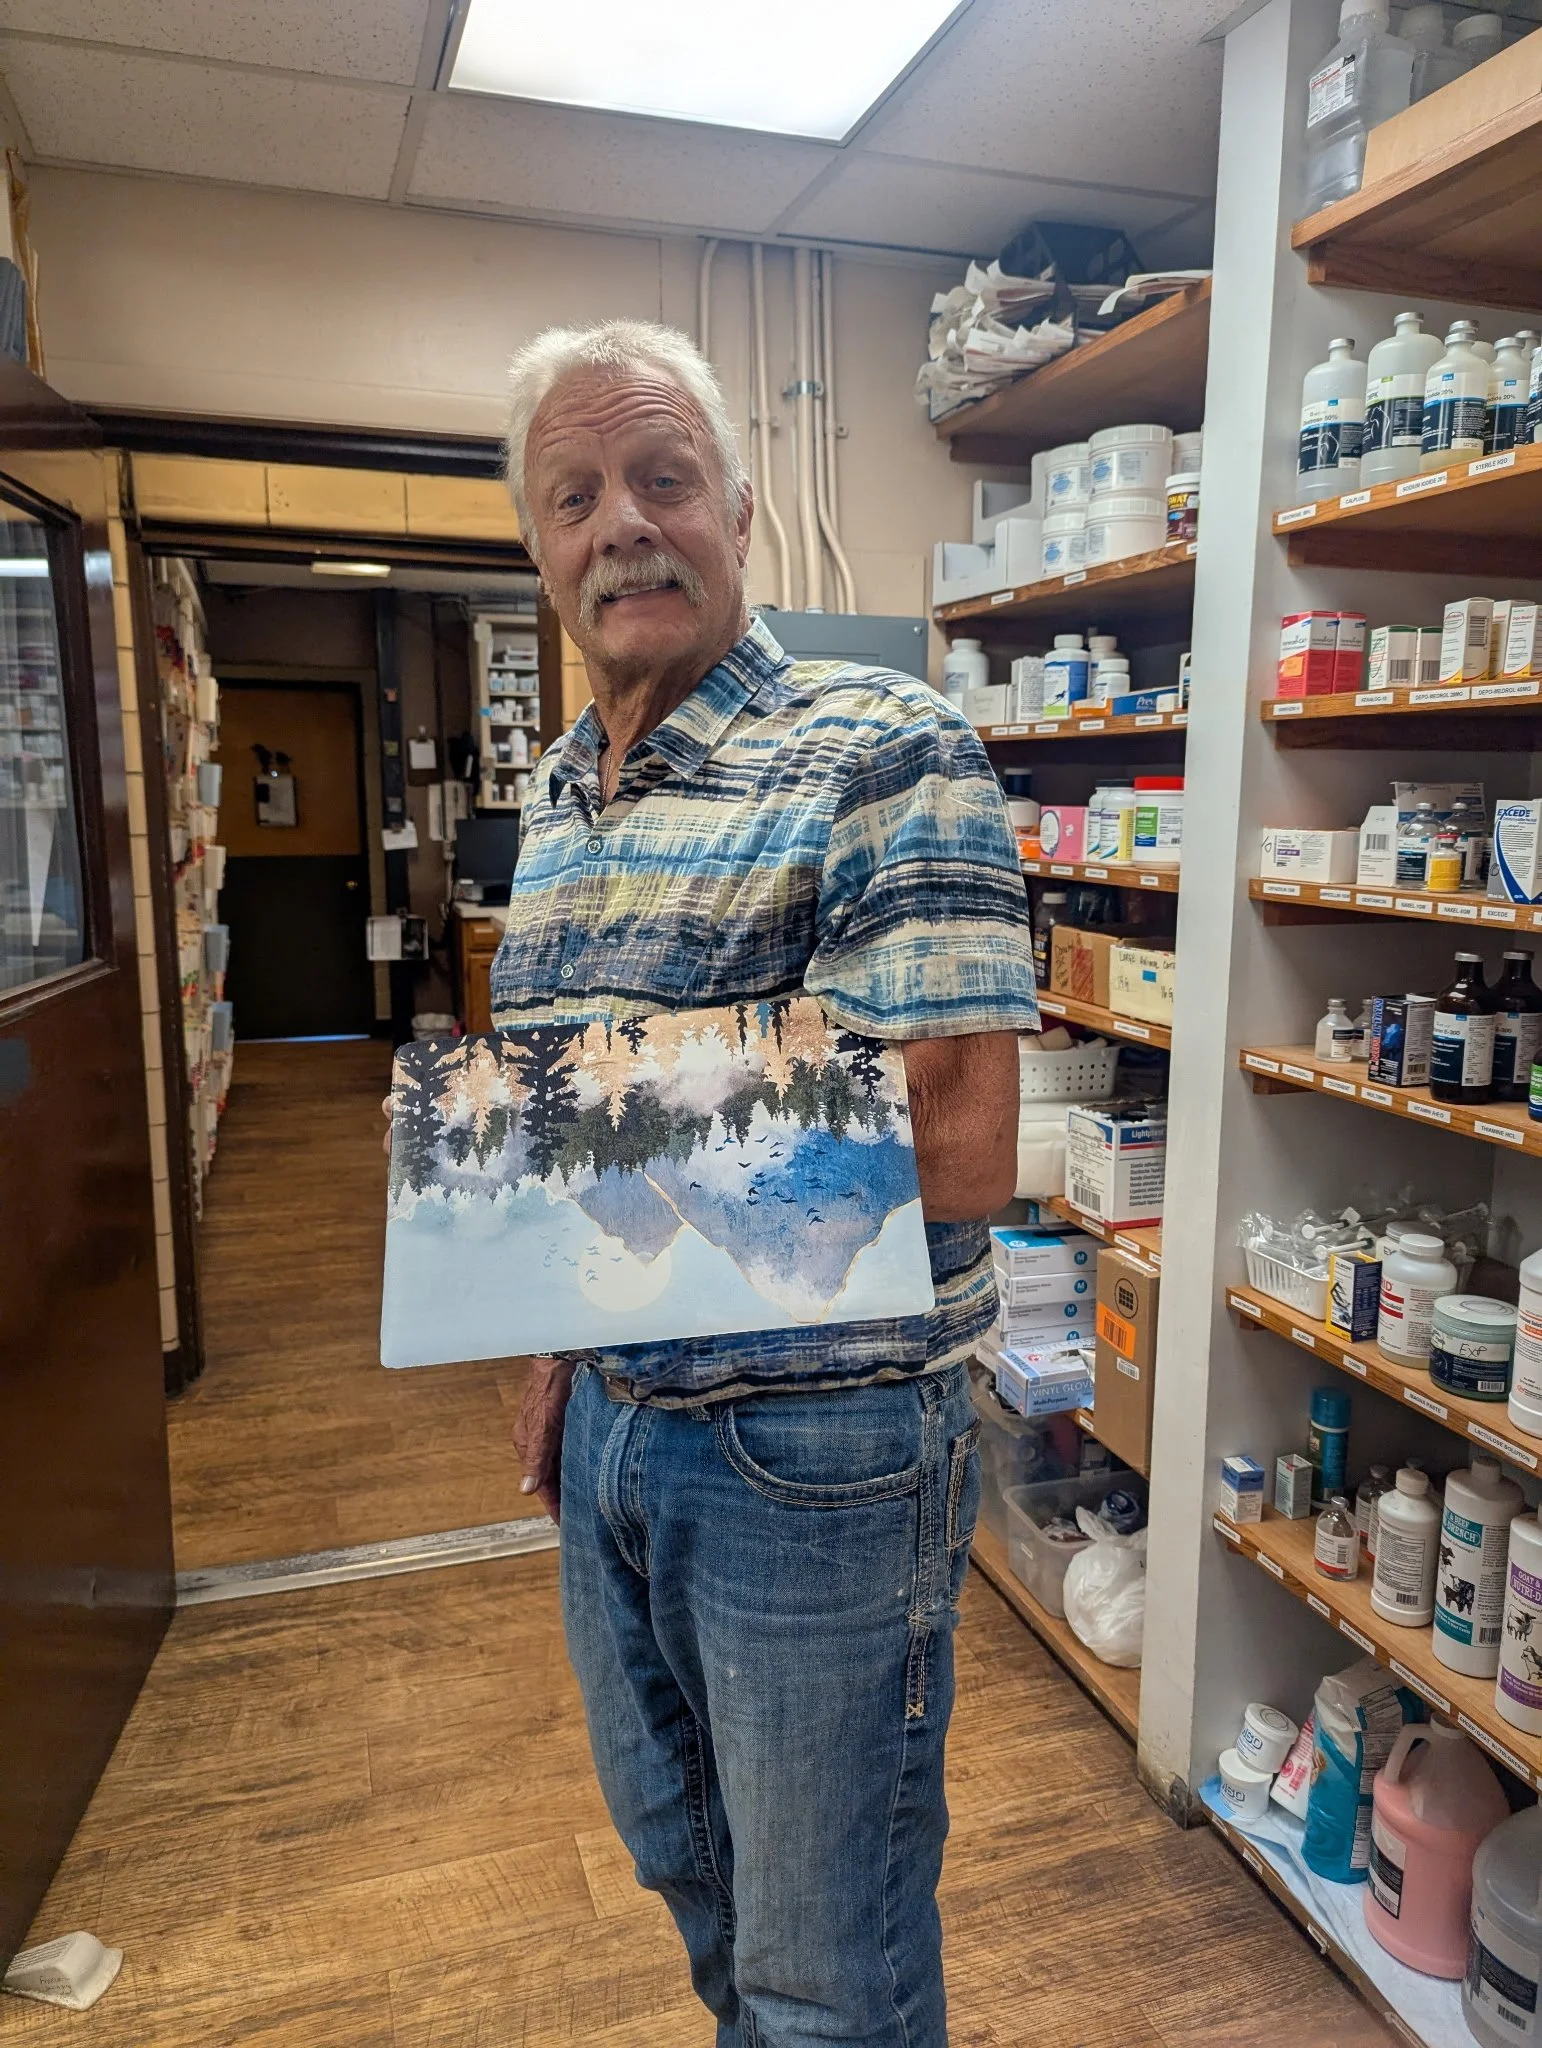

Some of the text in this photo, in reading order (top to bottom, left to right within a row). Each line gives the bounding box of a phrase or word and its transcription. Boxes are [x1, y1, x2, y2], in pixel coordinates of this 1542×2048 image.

[1497, 807, 1531, 817] EXCEDE
[1487, 910, 1508, 918] EXCEDE
[1481, 1125, 1504, 1136] THIAMINE
[1032, 1384, 1060, 1398] VINYL
[1426, 1401, 1442, 1414] PASTE
[1474, 1427, 1531, 1462] LACTULOSE SOLUTION
[1454, 1514, 1470, 1528] BEEF
[1518, 1570, 1541, 1588] GOAT &
[1512, 1577, 1542, 1602] NUTRI-D
[1491, 1742, 1529, 1776] NUTRI-DRENCH
